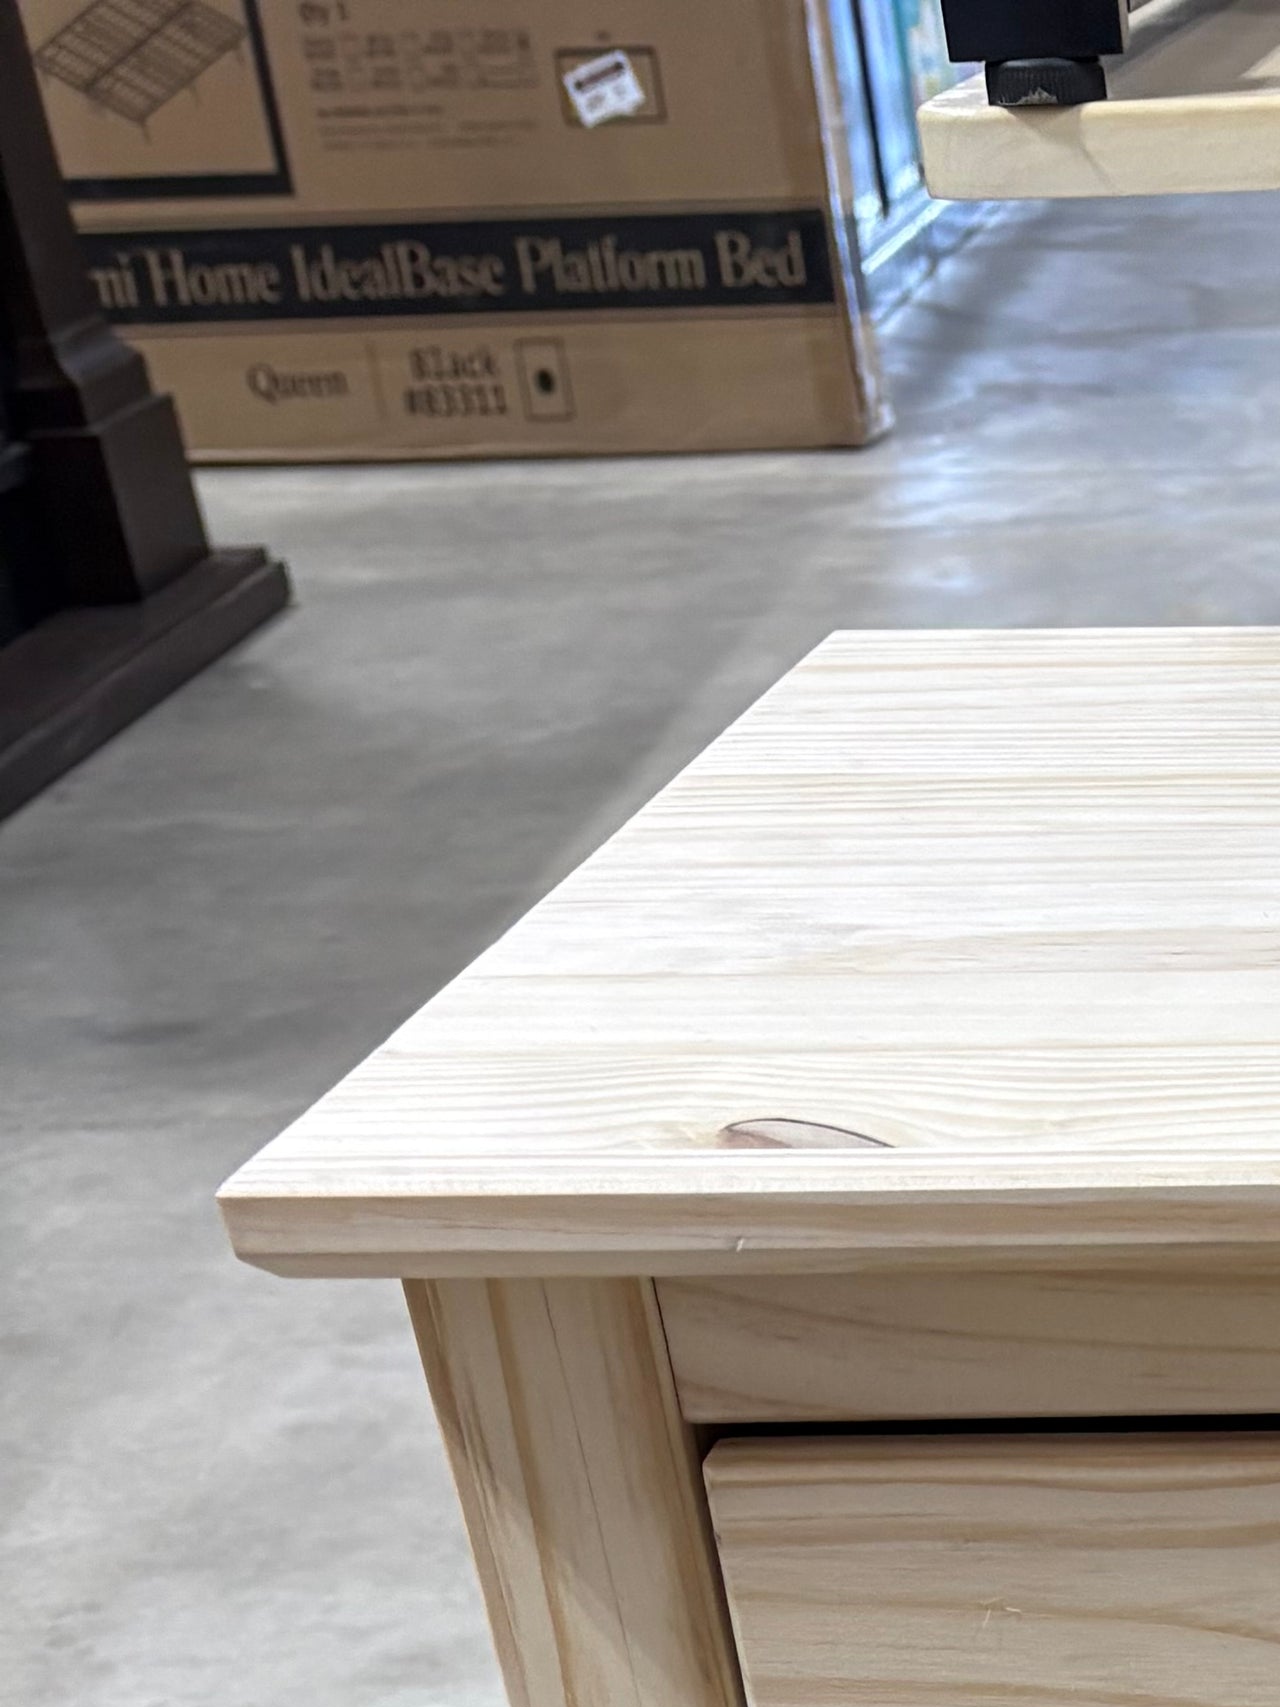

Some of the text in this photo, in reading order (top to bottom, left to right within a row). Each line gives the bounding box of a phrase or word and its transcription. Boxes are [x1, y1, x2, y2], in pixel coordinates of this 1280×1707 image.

[145, 247, 282, 306] Home
[290, 239, 505, 302] IdealBase
[514, 233, 706, 295] Platform
[713, 229, 807, 289] Bed
[246, 363, 348, 405] Queen
